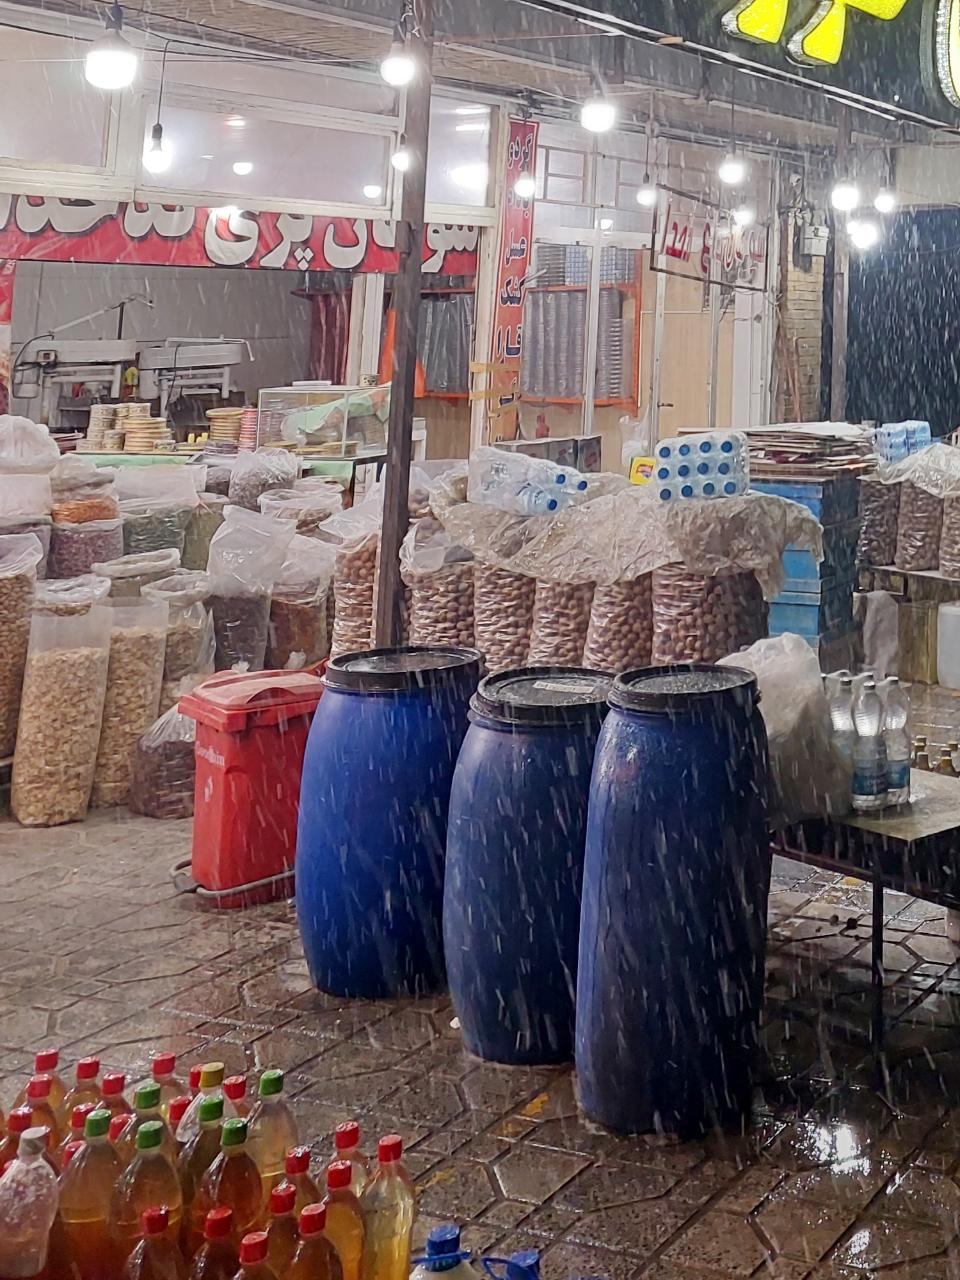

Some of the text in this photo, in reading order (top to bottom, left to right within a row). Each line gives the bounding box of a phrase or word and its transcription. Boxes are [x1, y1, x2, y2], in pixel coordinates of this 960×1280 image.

[508, 133, 533, 170] گردو
[504, 229, 526, 267] عسل
[500, 275, 526, 307] کشک
